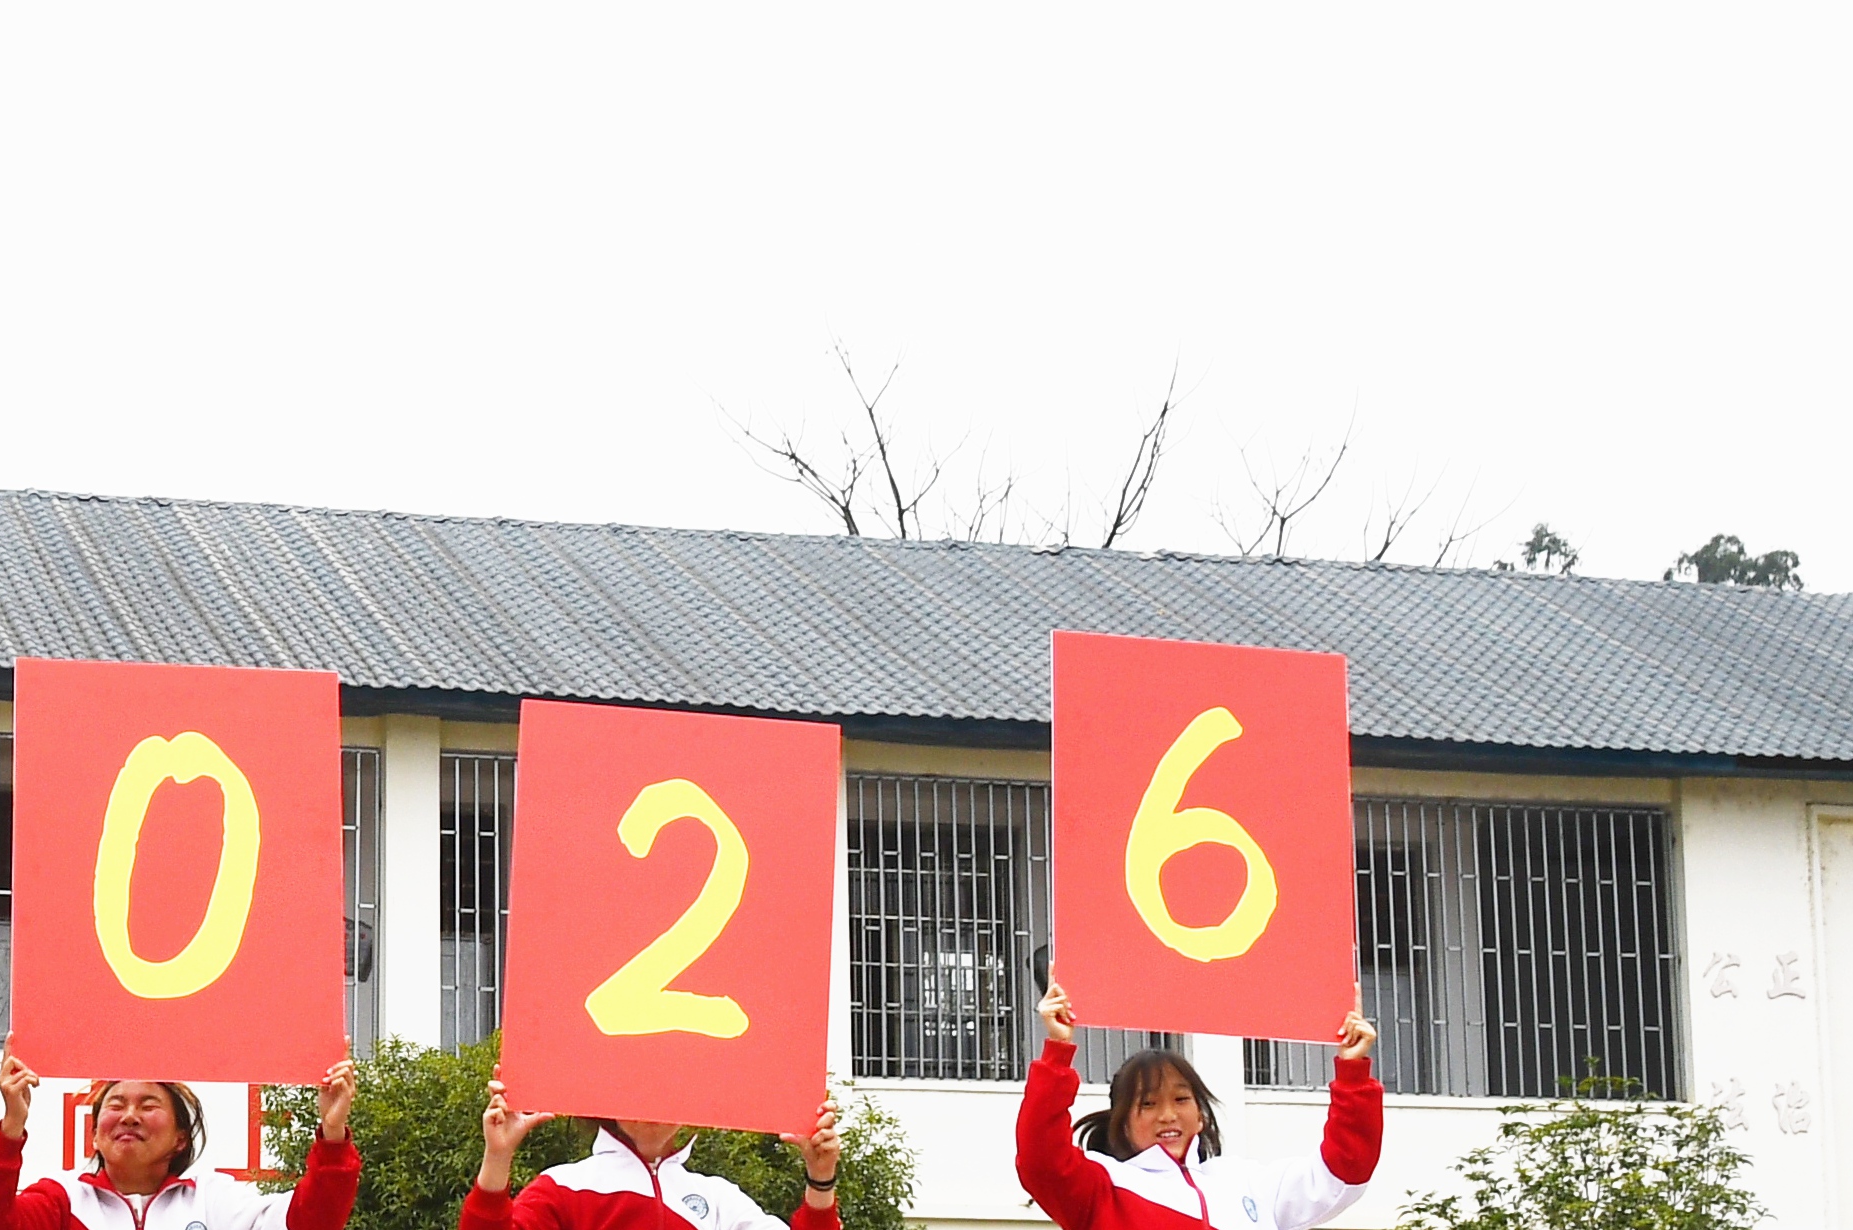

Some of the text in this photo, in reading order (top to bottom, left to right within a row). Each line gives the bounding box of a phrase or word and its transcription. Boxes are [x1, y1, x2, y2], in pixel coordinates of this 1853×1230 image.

[94, 732, 260, 998] 0
[585, 778, 750, 1038] 2
[1126, 707, 1278, 962] 6
[1703, 950, 1806, 999] 公正
